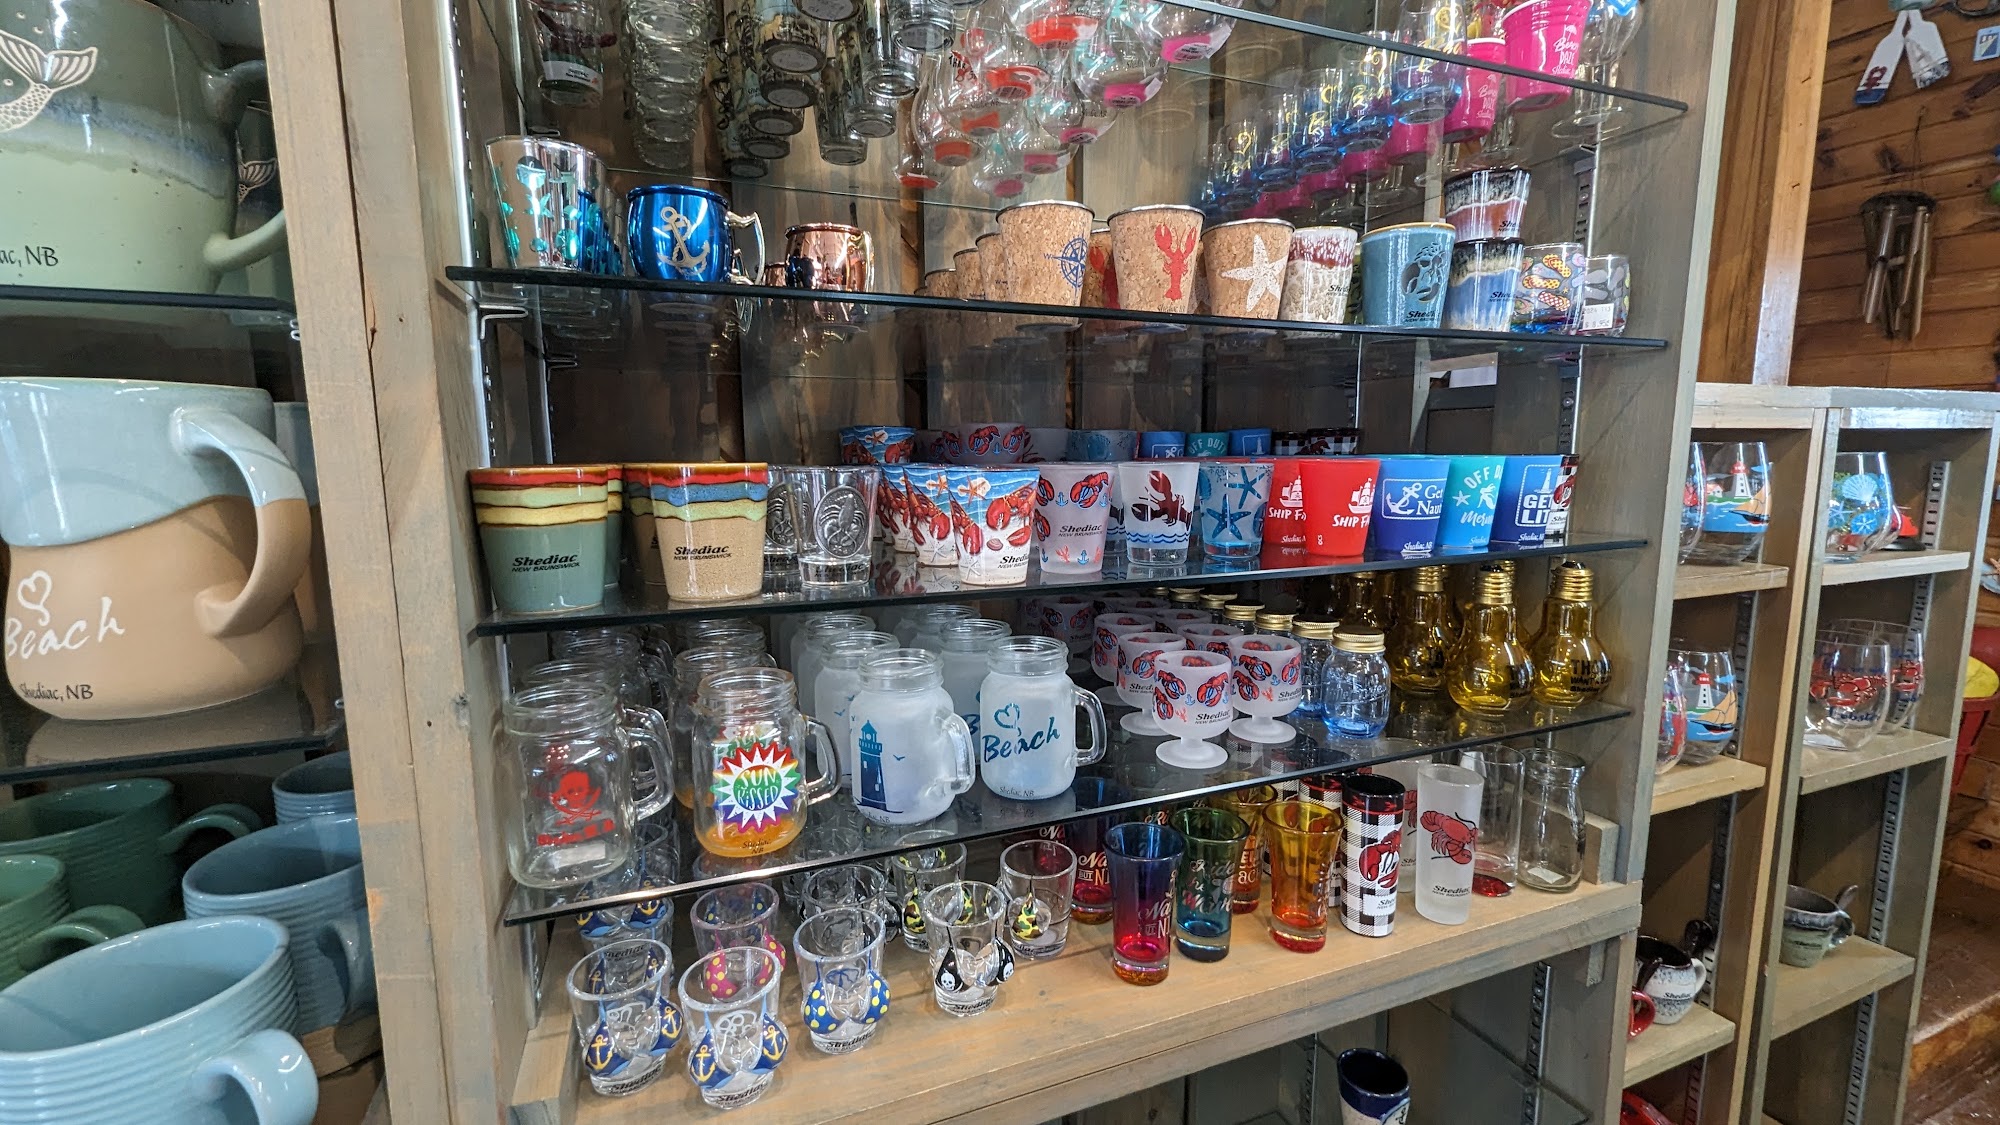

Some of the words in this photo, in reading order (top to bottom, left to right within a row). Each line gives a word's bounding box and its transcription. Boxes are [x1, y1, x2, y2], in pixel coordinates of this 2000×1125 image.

[25, 245, 58, 267] NB
[1463, 466, 1490, 489] OFF
[1268, 507, 1292, 520] SHIP
[1521, 510, 1549, 524] LIT
[1332, 514, 1359, 528] SHIP
[673, 545, 730, 556] Shediac
[690, 552, 733, 561] BRUNSWICK
[511, 565, 532, 573] NEW
[533, 561, 581, 572] BRUNSWICK
[512, 553, 579, 567] Shediac
[20, 681, 64, 702] Shediac,
[66, 684, 94, 700] NB
[982, 716, 1061, 763] Beach
[740, 766, 777, 790] SUN
